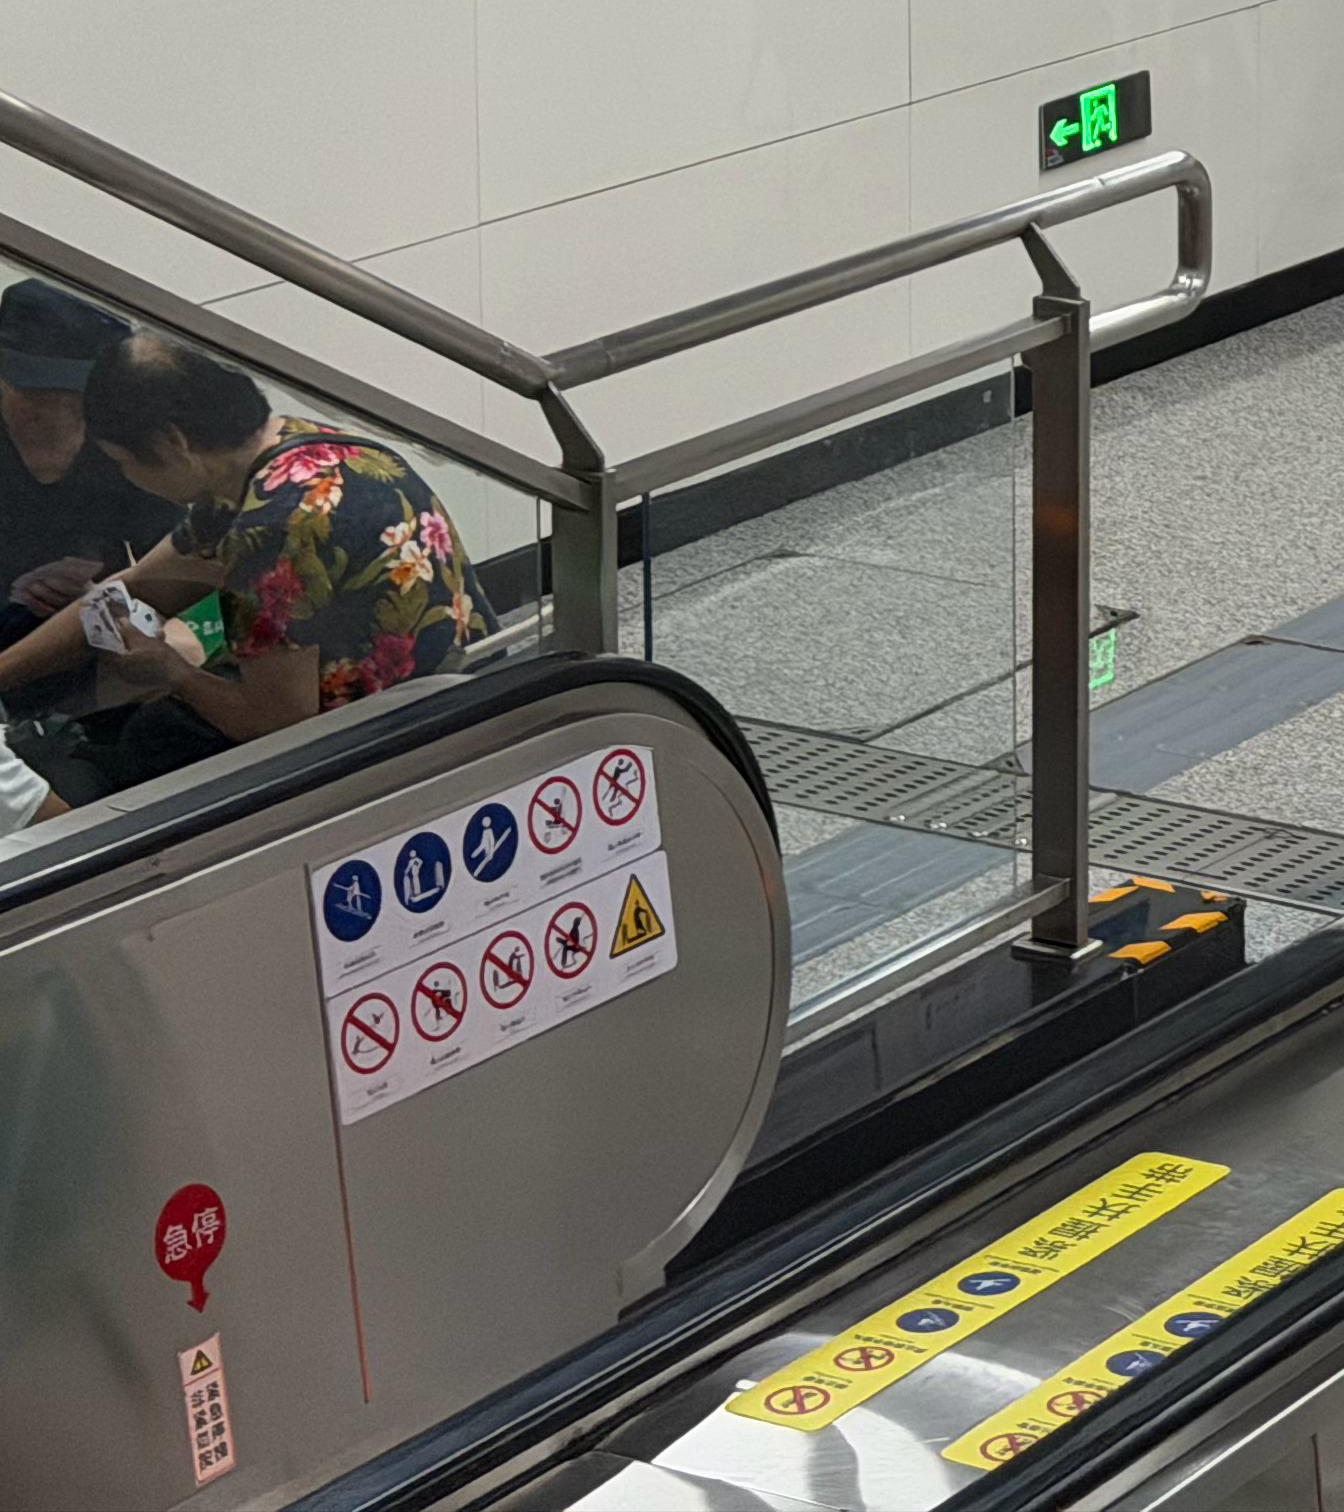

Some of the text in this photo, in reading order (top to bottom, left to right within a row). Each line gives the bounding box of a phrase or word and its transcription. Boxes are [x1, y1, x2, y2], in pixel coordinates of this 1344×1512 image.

[163, 1206, 222, 1264] 急停
[1018, 1163, 1194, 1260] 紧握扶手带
